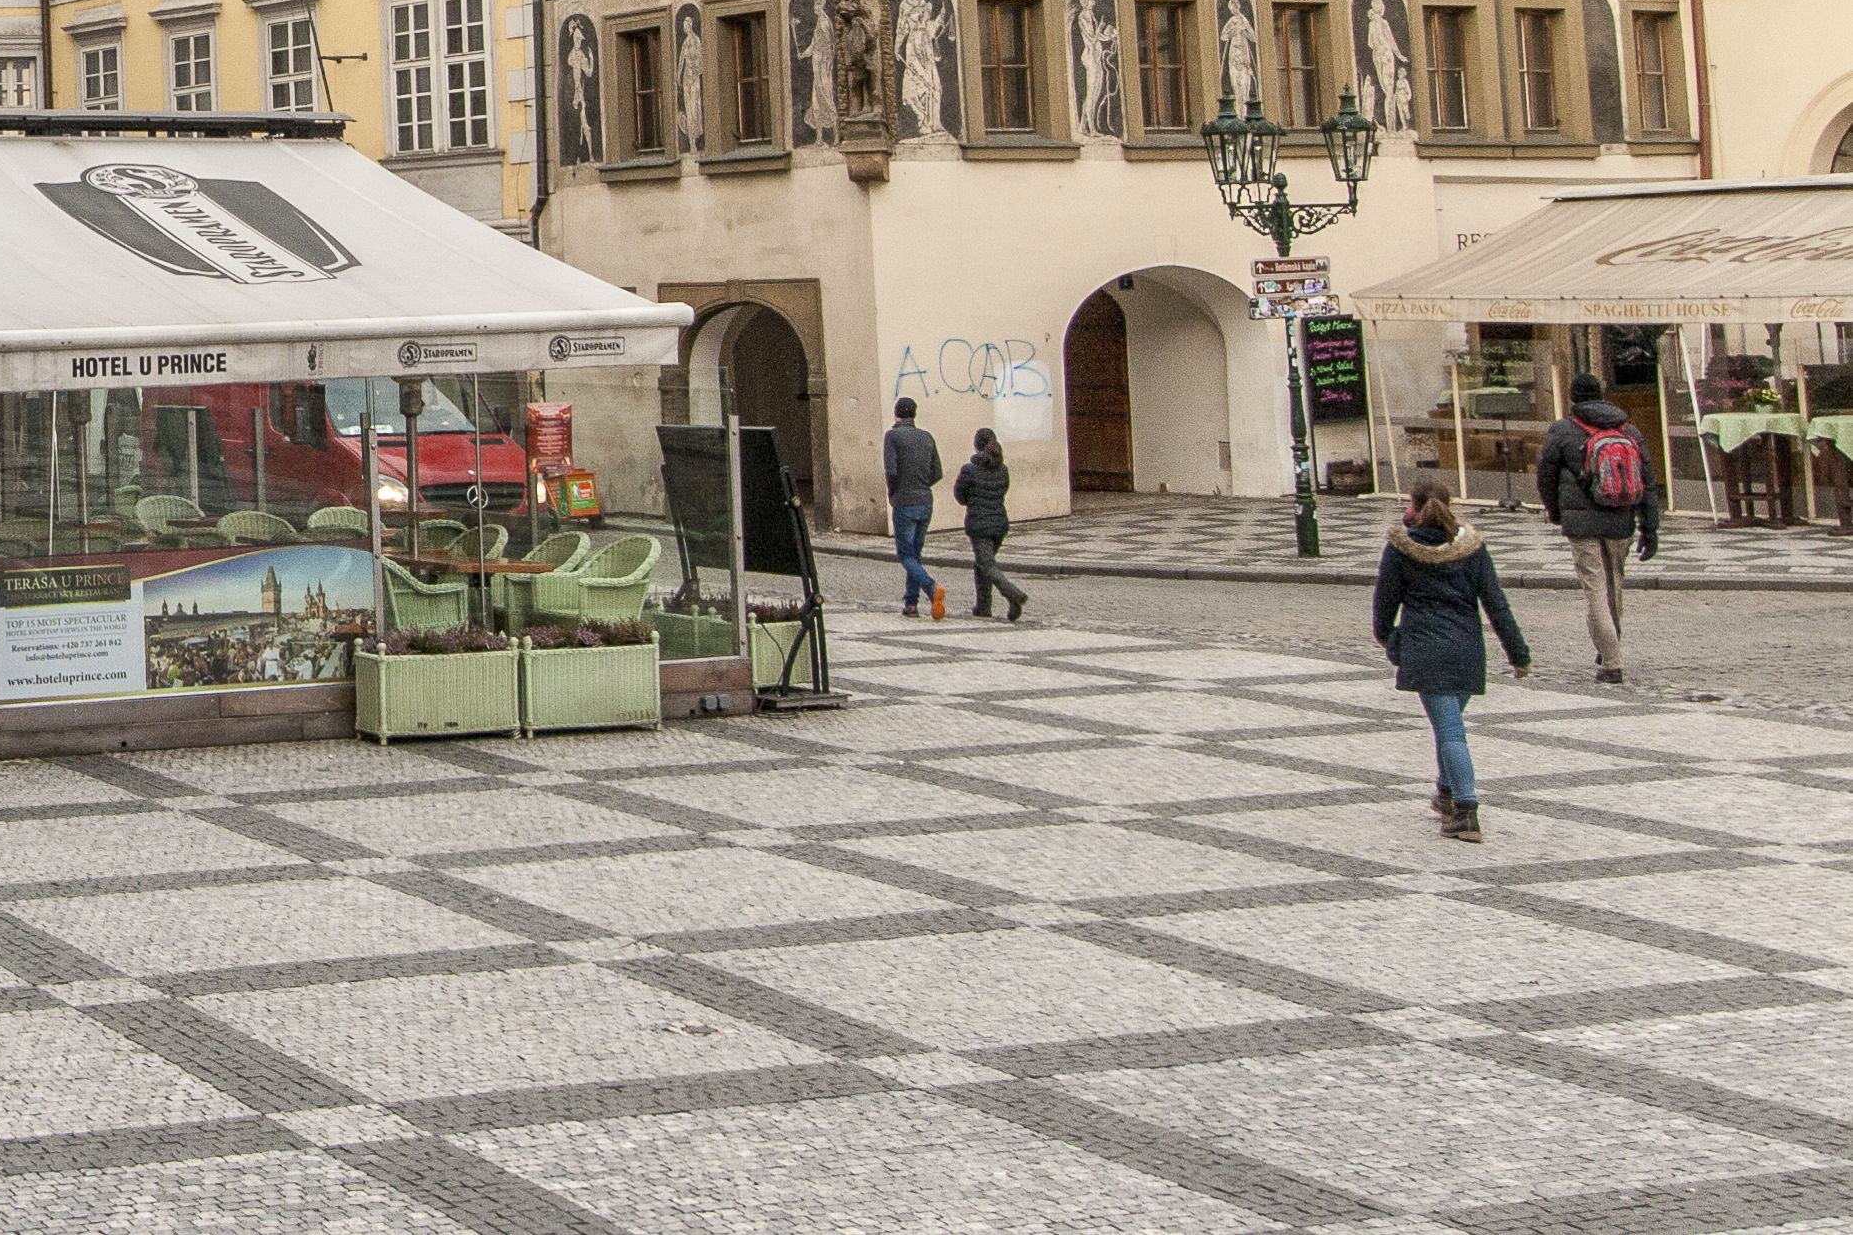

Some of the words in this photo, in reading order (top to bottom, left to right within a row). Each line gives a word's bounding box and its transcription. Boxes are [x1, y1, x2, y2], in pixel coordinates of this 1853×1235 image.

[154, 201, 305, 279] STAROPRAMEN
[1375, 303, 1406, 314] PIZZA
[1411, 303, 1444, 314] PASTA
[1584, 303, 1670, 317] SPAGHETTI
[1676, 302, 1732, 317] HOUSE
[423, 347, 473, 358] STAROPRAMEN
[573, 341, 621, 352] STAROPRAMEN
[72, 356, 133, 377] HOTEL
[139, 355, 152, 376] U
[157, 352, 227, 375] PRINCE
[4, 577, 57, 591] TERASA
[61, 575, 71, 588] U
[75, 572, 126, 586] PRINCE
[59, 590, 73, 598] SKY
[75, 587, 124, 597] RESTAURANT
[7, 621, 24, 629] TOP
[27, 620, 35, 628] 15
[37, 618, 62, 627] MOST
[64, 614, 127, 625] SPECTACULAR
[28, 628, 59, 636] ROOFTOP
[104, 624, 127, 632] WORLD
[12, 644, 59, 653] Reservations:
[7, 670, 127, 686] www.hoteluprince.com
